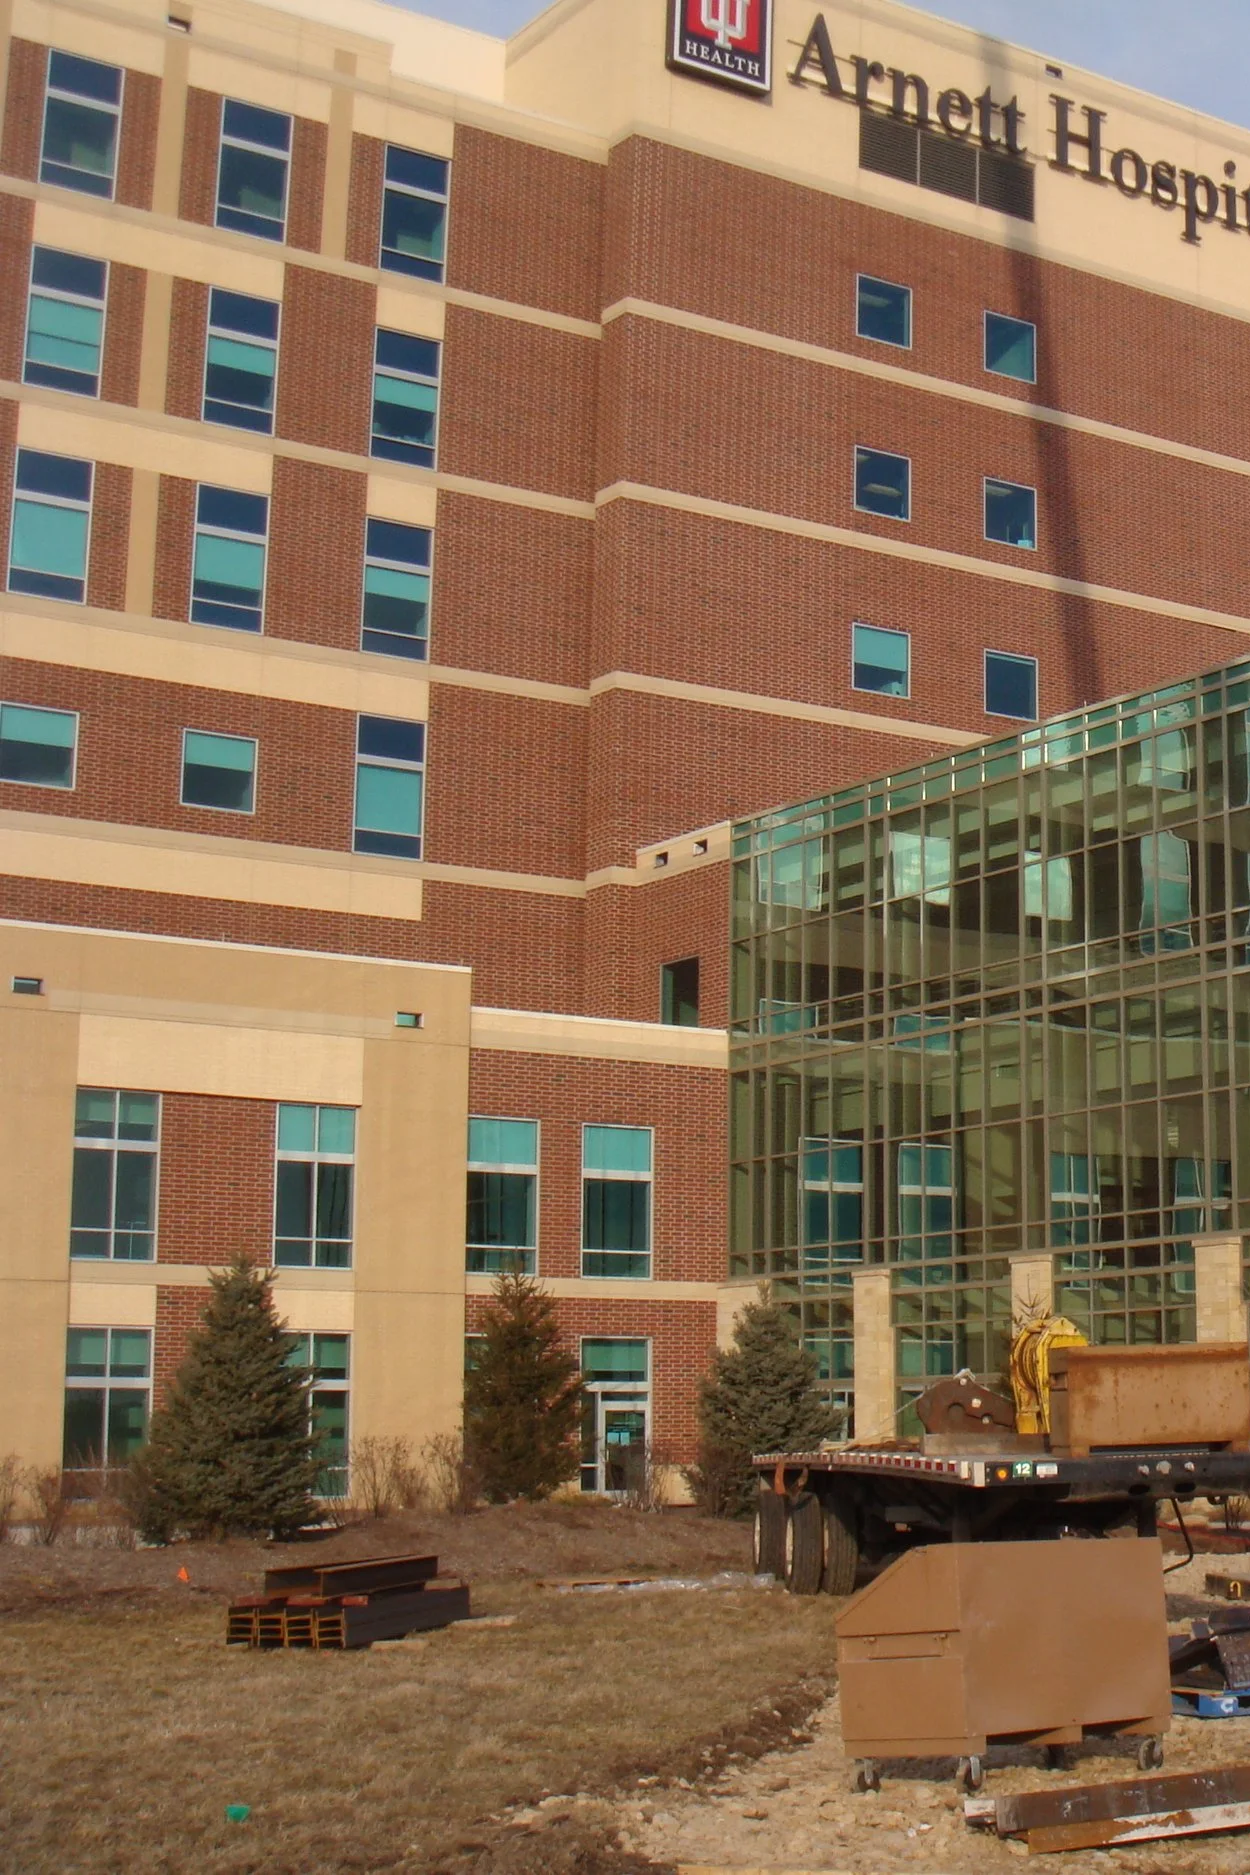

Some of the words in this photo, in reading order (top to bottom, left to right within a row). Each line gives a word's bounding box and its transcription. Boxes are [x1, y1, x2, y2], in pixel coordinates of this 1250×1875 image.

[685, 39, 760, 77] HEALTH
[787, 12, 1027, 154] Arnett
[1015, 1463, 1031, 1475] 12
